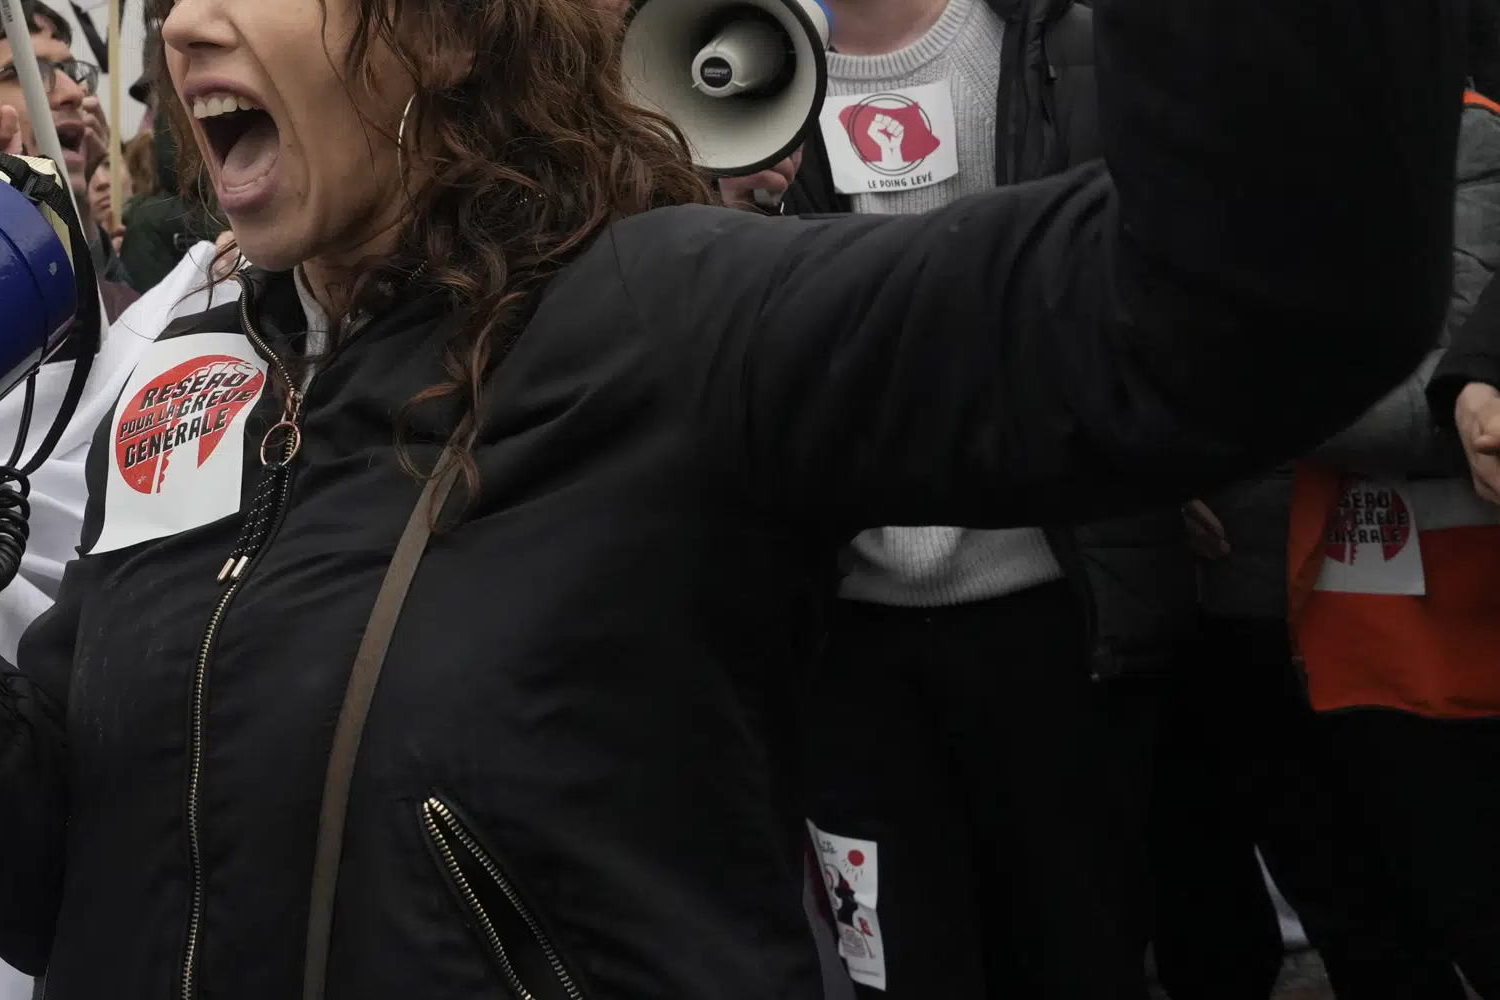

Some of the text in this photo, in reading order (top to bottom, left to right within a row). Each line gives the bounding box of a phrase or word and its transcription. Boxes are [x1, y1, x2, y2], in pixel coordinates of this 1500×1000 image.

[867, 171, 933, 189] LE POING LEVÉ
[119, 412, 155, 439] POUR
[157, 403, 175, 422] LA
